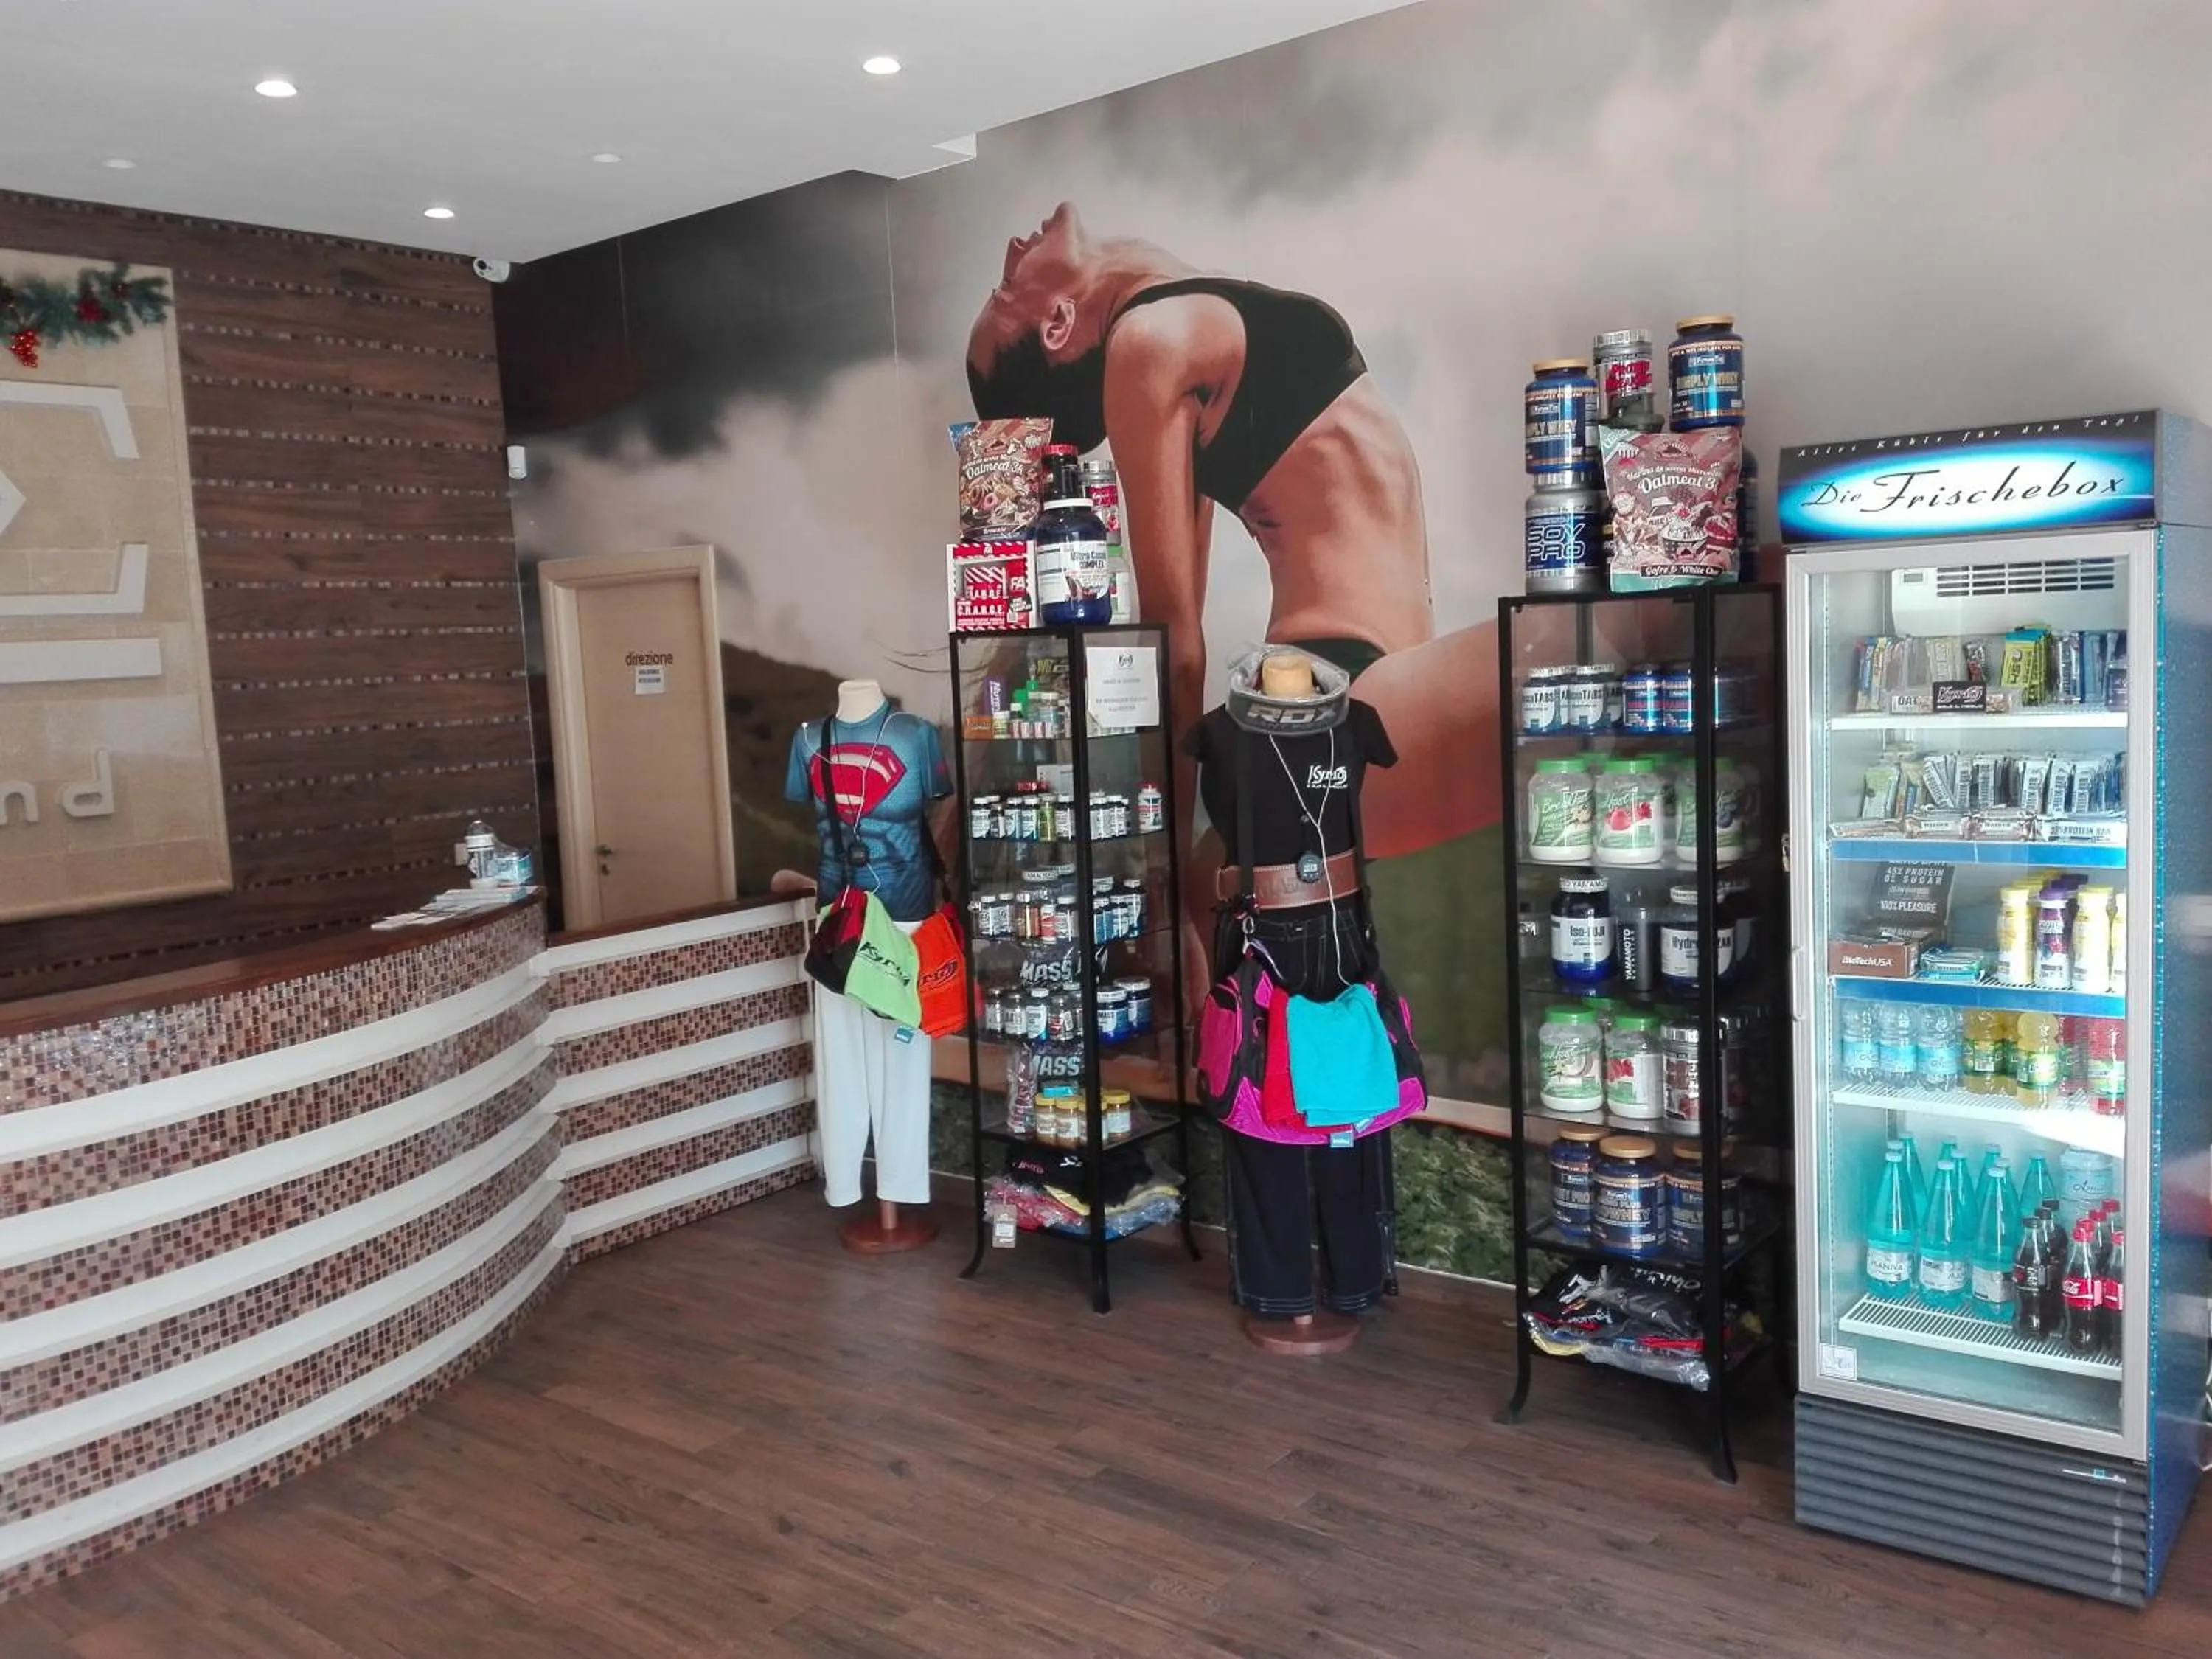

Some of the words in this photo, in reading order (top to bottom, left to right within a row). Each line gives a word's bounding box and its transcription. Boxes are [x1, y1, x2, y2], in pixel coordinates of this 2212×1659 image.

[1638, 474, 1702, 494] Oatmeal
[1800, 481, 1863, 507] Die
[1858, 459, 2125, 512] Frischebox
[1527, 523, 1586, 543] SOY
[1904, 867, 1945, 877] PROTEIN
[1898, 901, 1938, 914] PLEASURE
